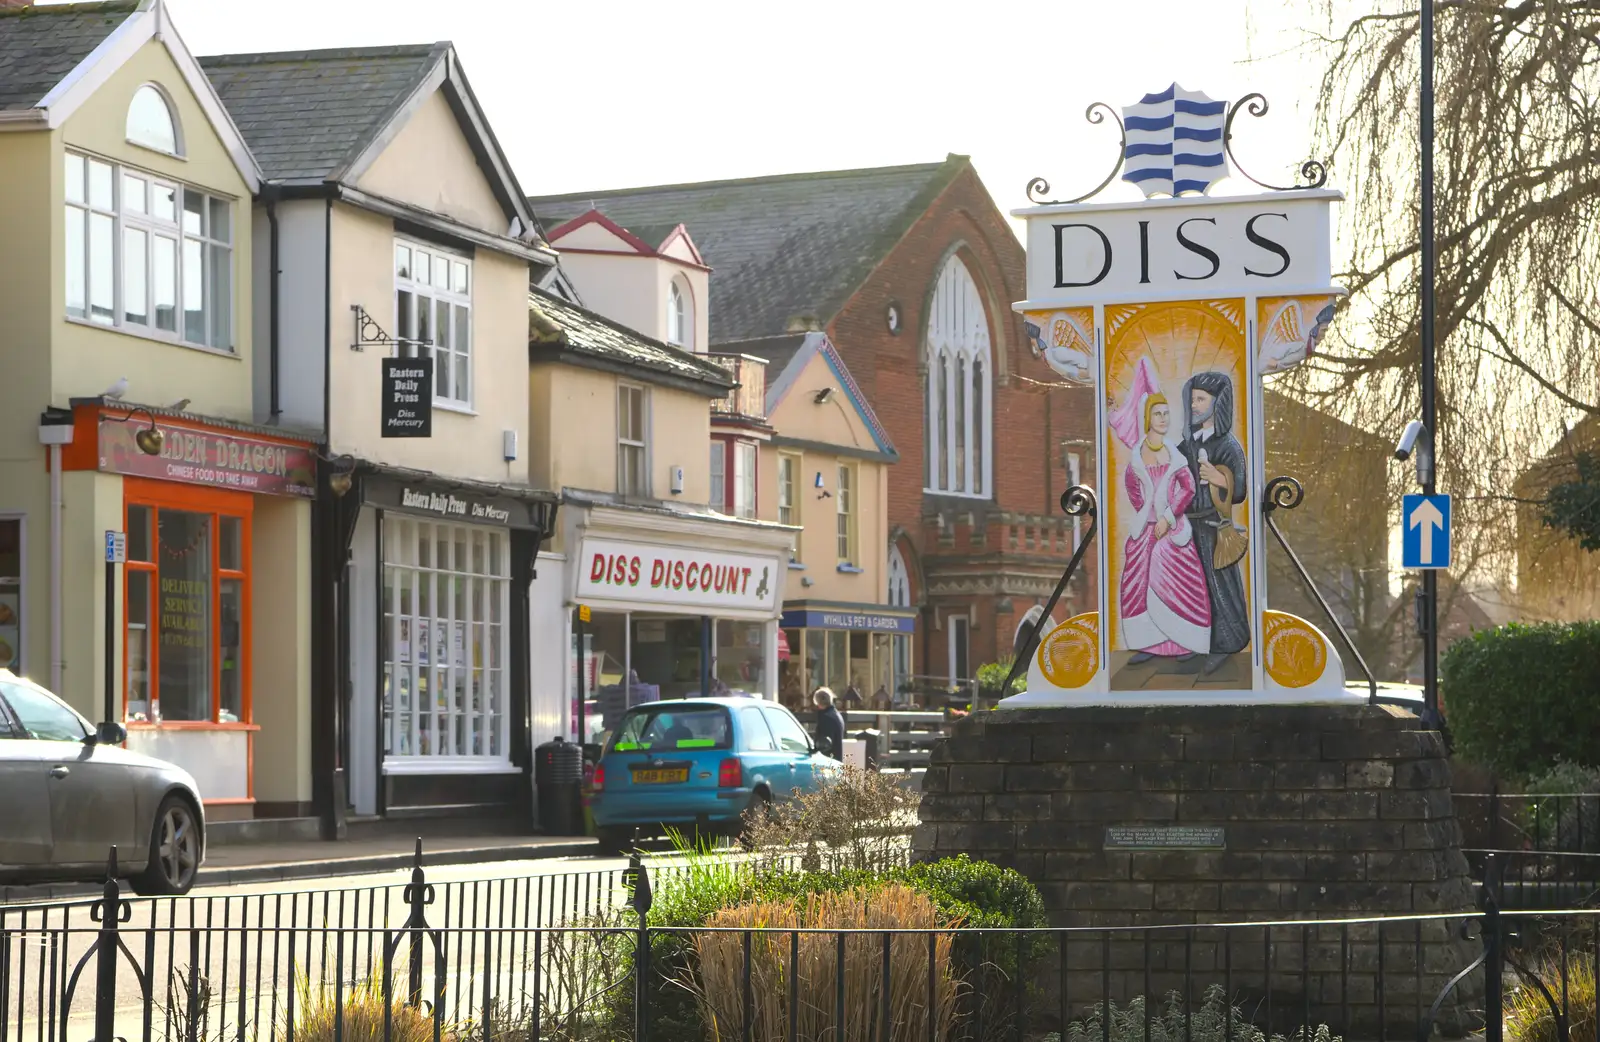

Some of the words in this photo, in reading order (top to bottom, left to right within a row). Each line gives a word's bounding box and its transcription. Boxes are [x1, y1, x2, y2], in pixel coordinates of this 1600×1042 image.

[1051, 212, 1291, 289] DISS
[389, 367, 424, 378] Eastern
[394, 379, 418, 392] Daily
[394, 392, 419, 403] Press
[397, 409, 415, 418] Diss
[388, 418, 424, 428] Mercury
[135, 424, 207, 468] LDEN
[216, 438, 287, 477] DRAGON
[166, 463, 194, 479] CHINESE
[195, 467, 215, 481] FOOD
[216, 470, 225, 483] TO
[225, 472, 240, 485] TAKE
[241, 475, 259, 487] AWAY
[402, 487, 430, 509] Eastern
[430, 492, 448, 515] Daily
[448, 495, 467, 515] Press
[472, 502, 485, 517] Diss
[485, 504, 510, 524] Mercury
[590, 553, 641, 587] DISS
[650, 558, 752, 595] DISCOUNT
[853, 615, 866, 628] PET
[873, 616, 898, 629] GARDEN
